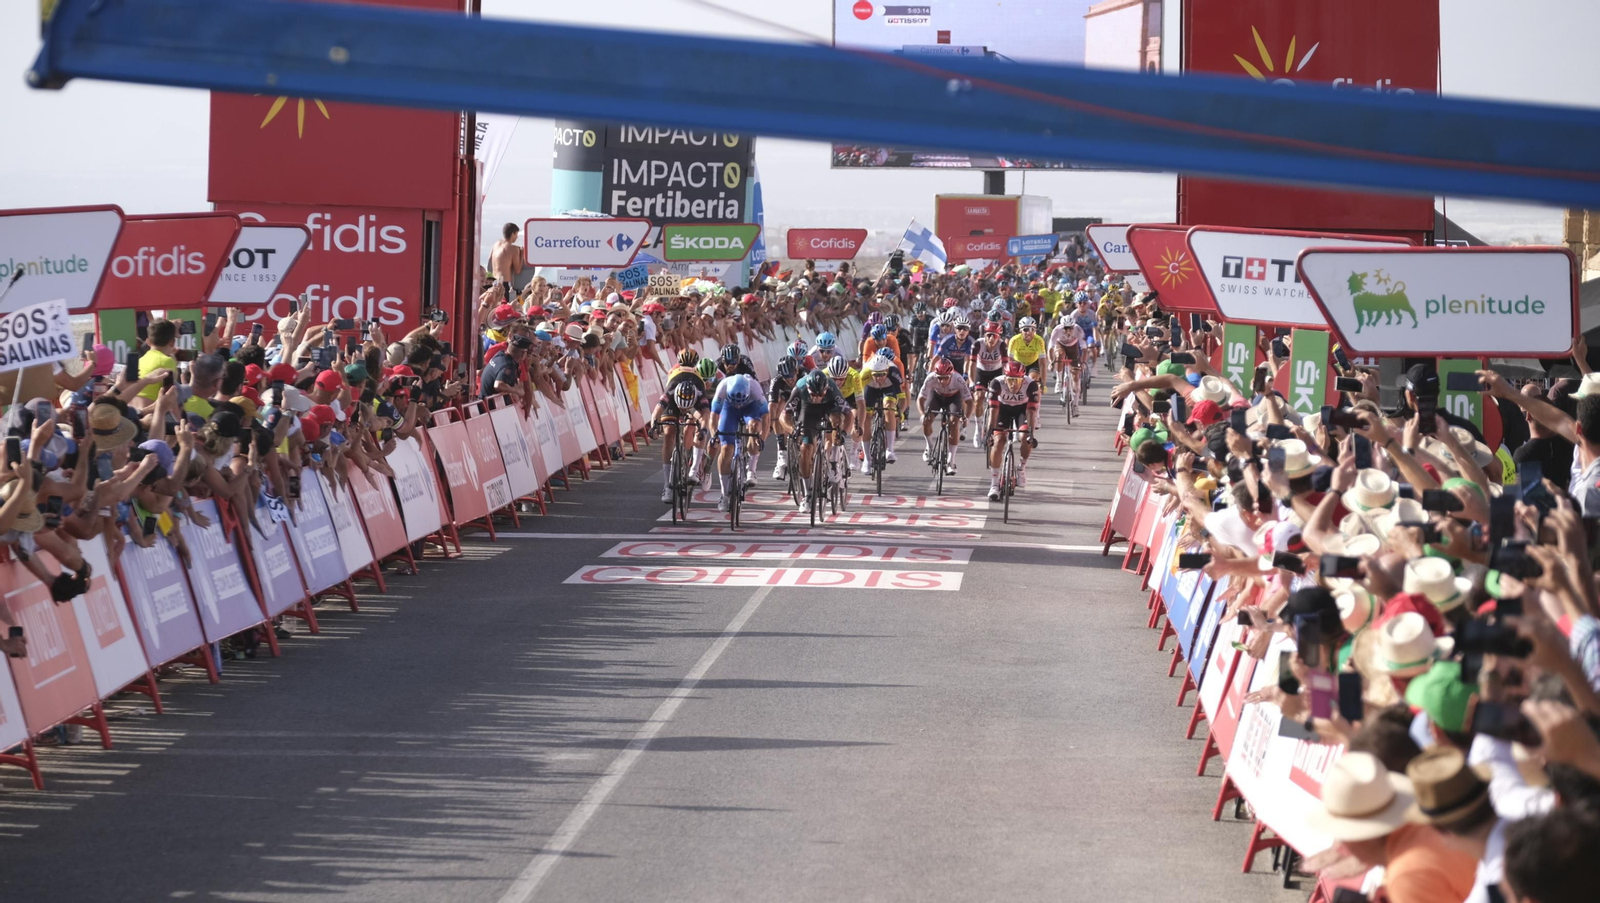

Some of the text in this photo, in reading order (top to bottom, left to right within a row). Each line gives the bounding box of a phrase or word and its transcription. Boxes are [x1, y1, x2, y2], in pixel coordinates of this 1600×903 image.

[611, 190, 740, 219] Fertiberia
[534, 236, 601, 249] Carrefour
[670, 234, 745, 249] ŠKODA
[810, 237, 856, 249] Cofidis
[966, 242, 1001, 251] Cofidis
[252, 273, 277, 282] 1853
[617, 268, 641, 282] SOS
[650, 276, 673, 287] SOS
[1220, 283, 1258, 295] SWISS
[1425, 294, 1546, 319] plenitude
[0, 308, 48, 342] SOS
[0, 333, 72, 366] SALINAS
[980, 351, 999, 361] UAE
[1002, 391, 1024, 401] UAE
[616, 542, 954, 563] COFIDIS
[579, 567, 944, 590] COFIDIS
